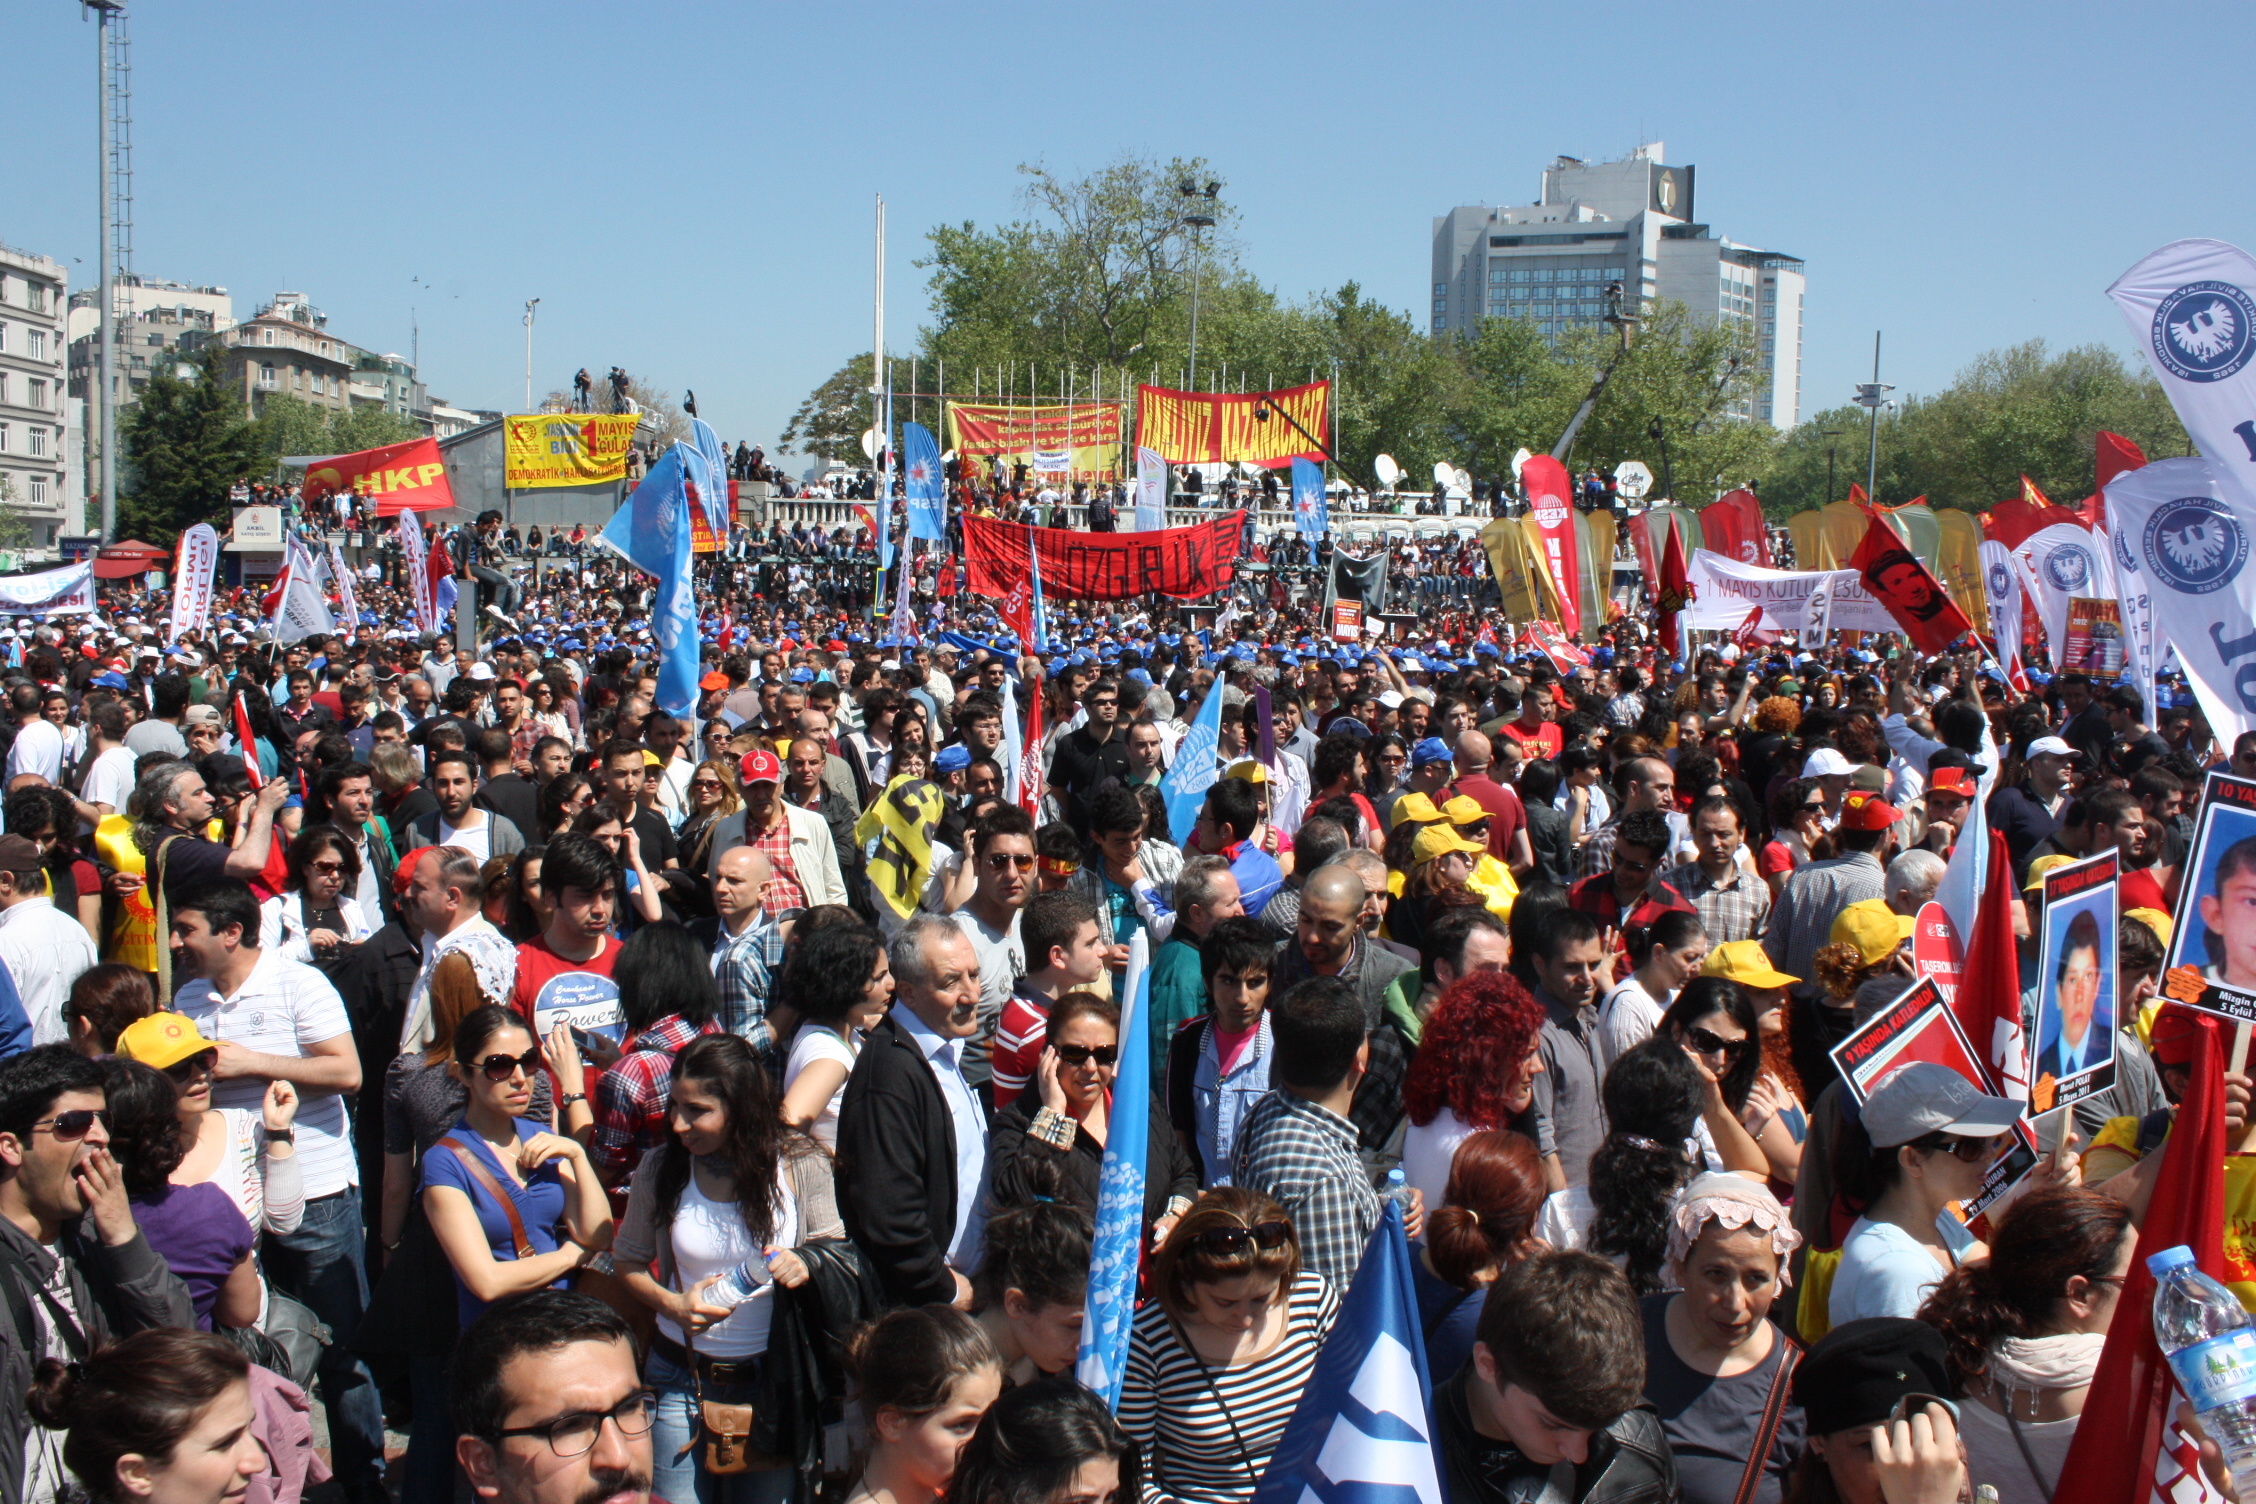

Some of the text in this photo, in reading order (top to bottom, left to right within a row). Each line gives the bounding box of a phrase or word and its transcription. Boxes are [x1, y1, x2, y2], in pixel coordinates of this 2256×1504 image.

[997, 418, 1117, 435] kapitalist sömürüye,
[1140, 386, 1325, 463] HAKLIYIZ KAZANACAĞIZ
[581, 419, 598, 457] 1
[598, 421, 636, 436] MAYIS
[999, 438, 1031, 449] baskı
[1049, 435, 1087, 445] teröre
[1089, 432, 1117, 444] karşı
[599, 440, 629, 454] GULA
[353, 462, 445, 496] HKP
[508, 464, 626, 480] DEMOKRATİK HAKLAR FEDERAS
[1707, 578, 1712, 598] 1
[1718, 578, 1762, 599] MAYIS
[1832, 577, 1874, 599] LSU
[284, 607, 306, 629] GRESİ
[1834, 604, 1873, 616] alışanları
[2072, 618, 2088, 626] 2012
[1336, 624, 1359, 638] MAYIS
[2217, 781, 2235, 798] 10
[552, 992, 604, 1005] Horse Power
[2218, 990, 2251, 1007] Mizgin
[551, 1009, 618, 1027] Power
[2220, 1002, 2253, 1018] 5 Eylül
[1844, 1050, 1856, 1065] 9
[1851, 1024, 1893, 1060] YAŞINDA
[1889, 983, 1936, 1031] KATLEDİLDİ
[2059, 1095, 2063, 1106] 5
[2078, 1084, 2090, 1098] 2011
[1985, 1165, 2007, 1188] DURAN
[1969, 1204, 1978, 1216] 29
[1977, 1192, 1993, 1211] Mart
[1992, 1181, 2009, 1198] 2006
